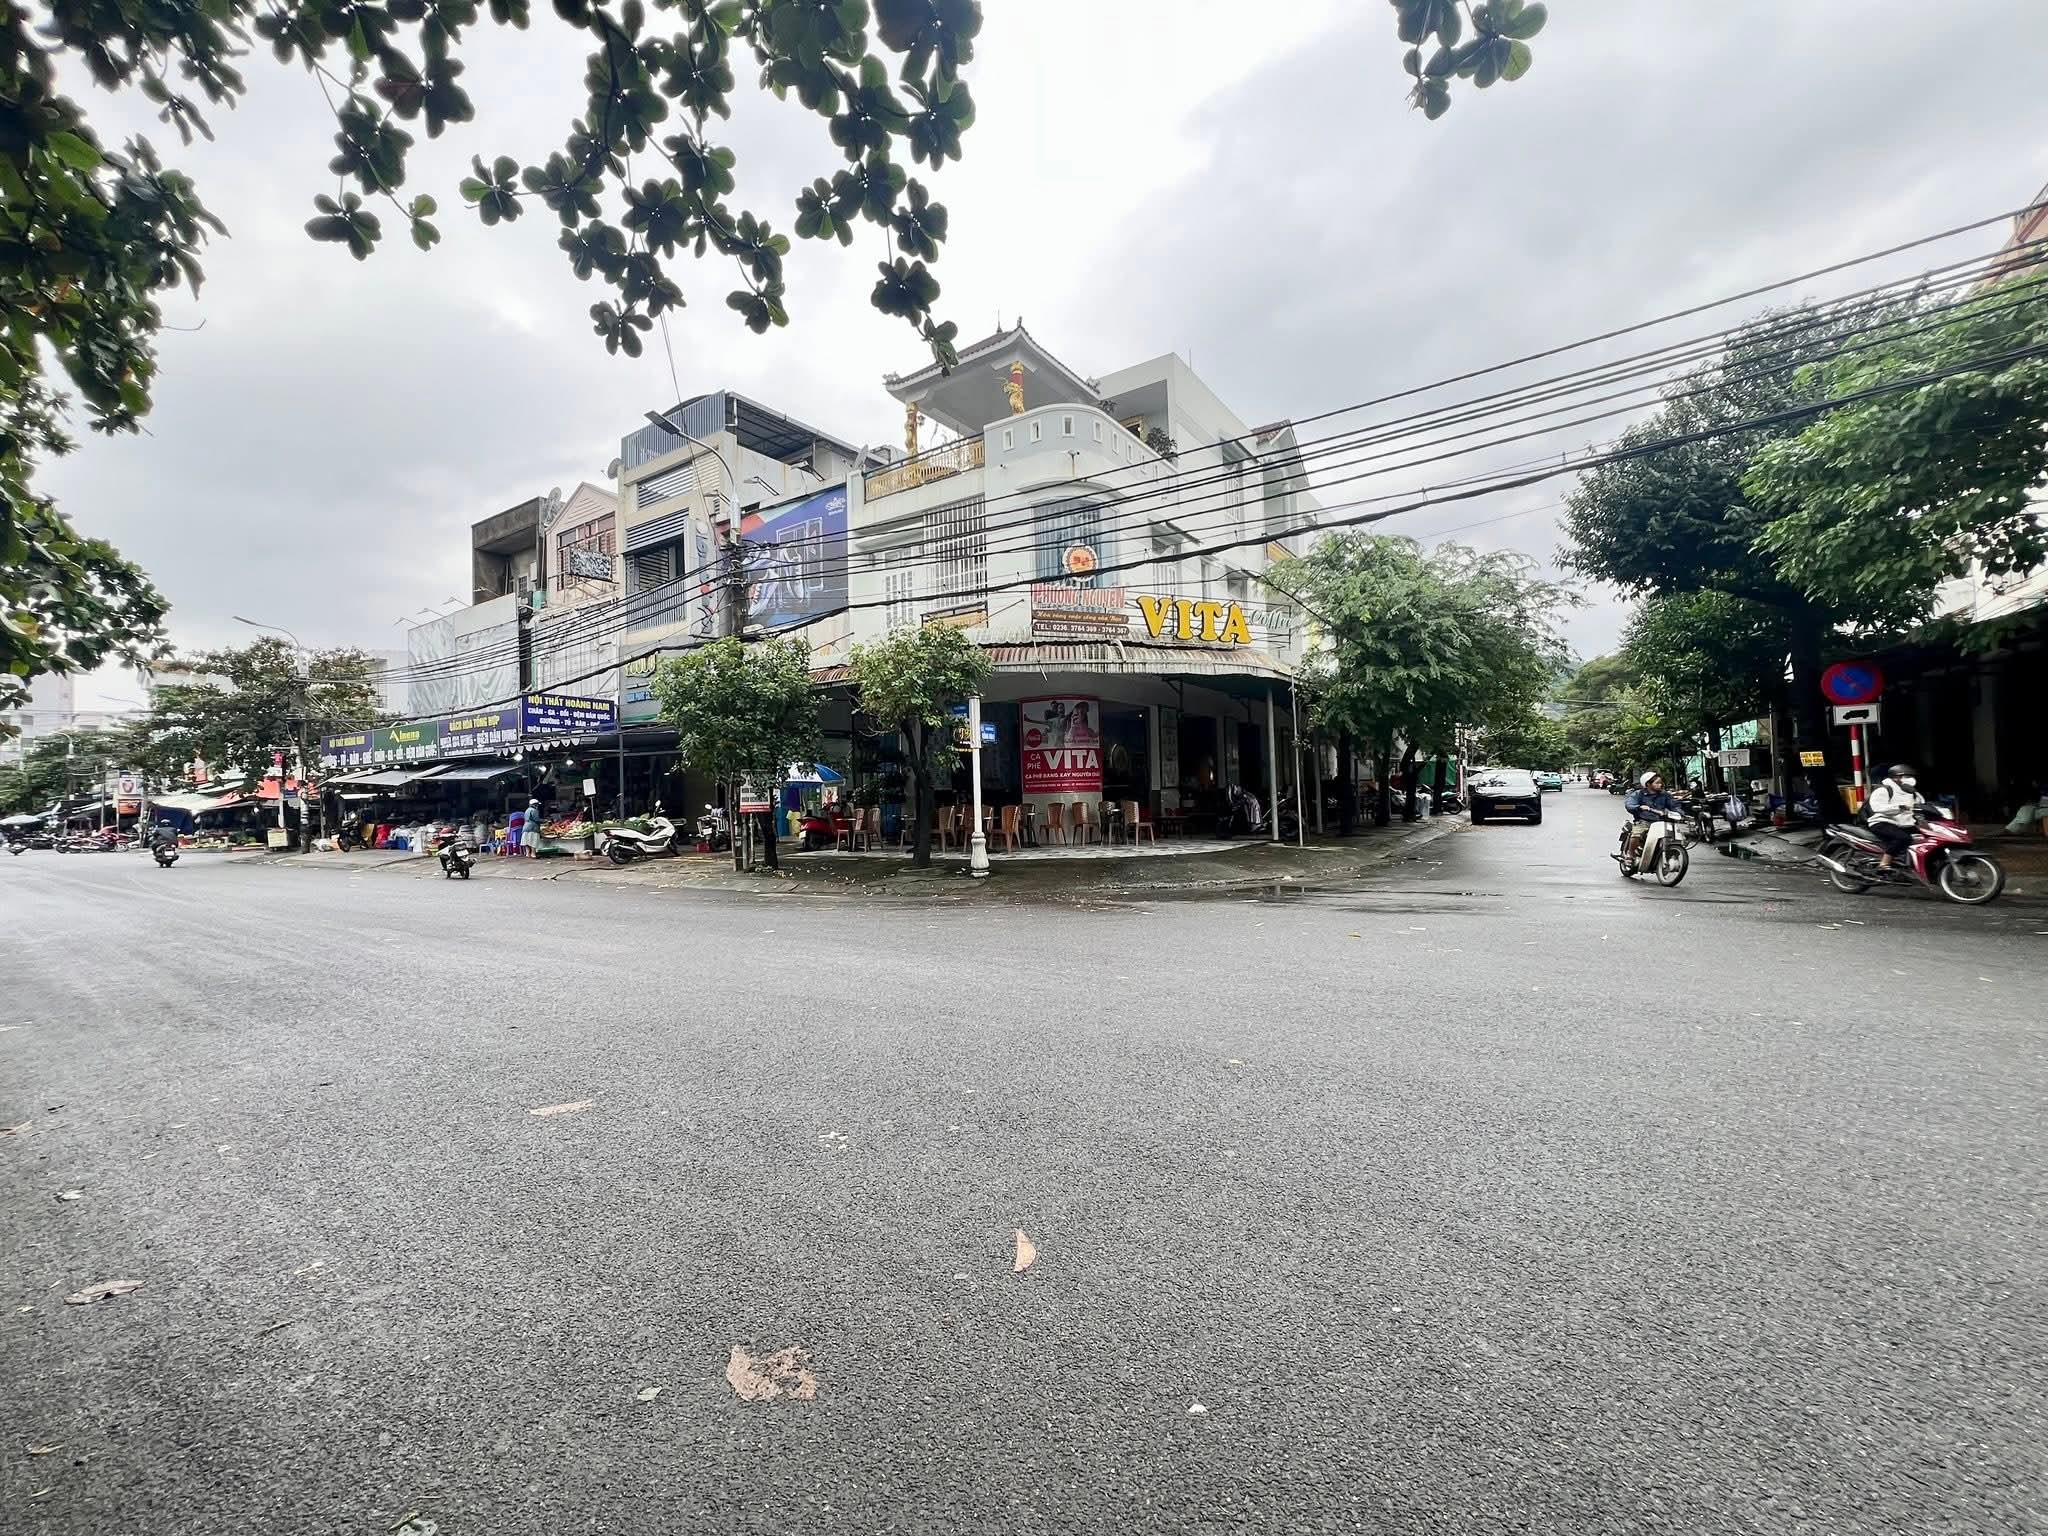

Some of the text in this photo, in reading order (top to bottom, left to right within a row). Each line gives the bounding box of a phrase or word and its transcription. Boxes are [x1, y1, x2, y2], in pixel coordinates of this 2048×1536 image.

[1036, 623, 1051, 631] TEL:
[1136, 596, 1252, 644] VITA
[1250, 606, 1291, 630] Coffee
[528, 694, 610, 711] NỘI THẤT HOÀNG NAM
[1043, 749, 1099, 769] VITA
